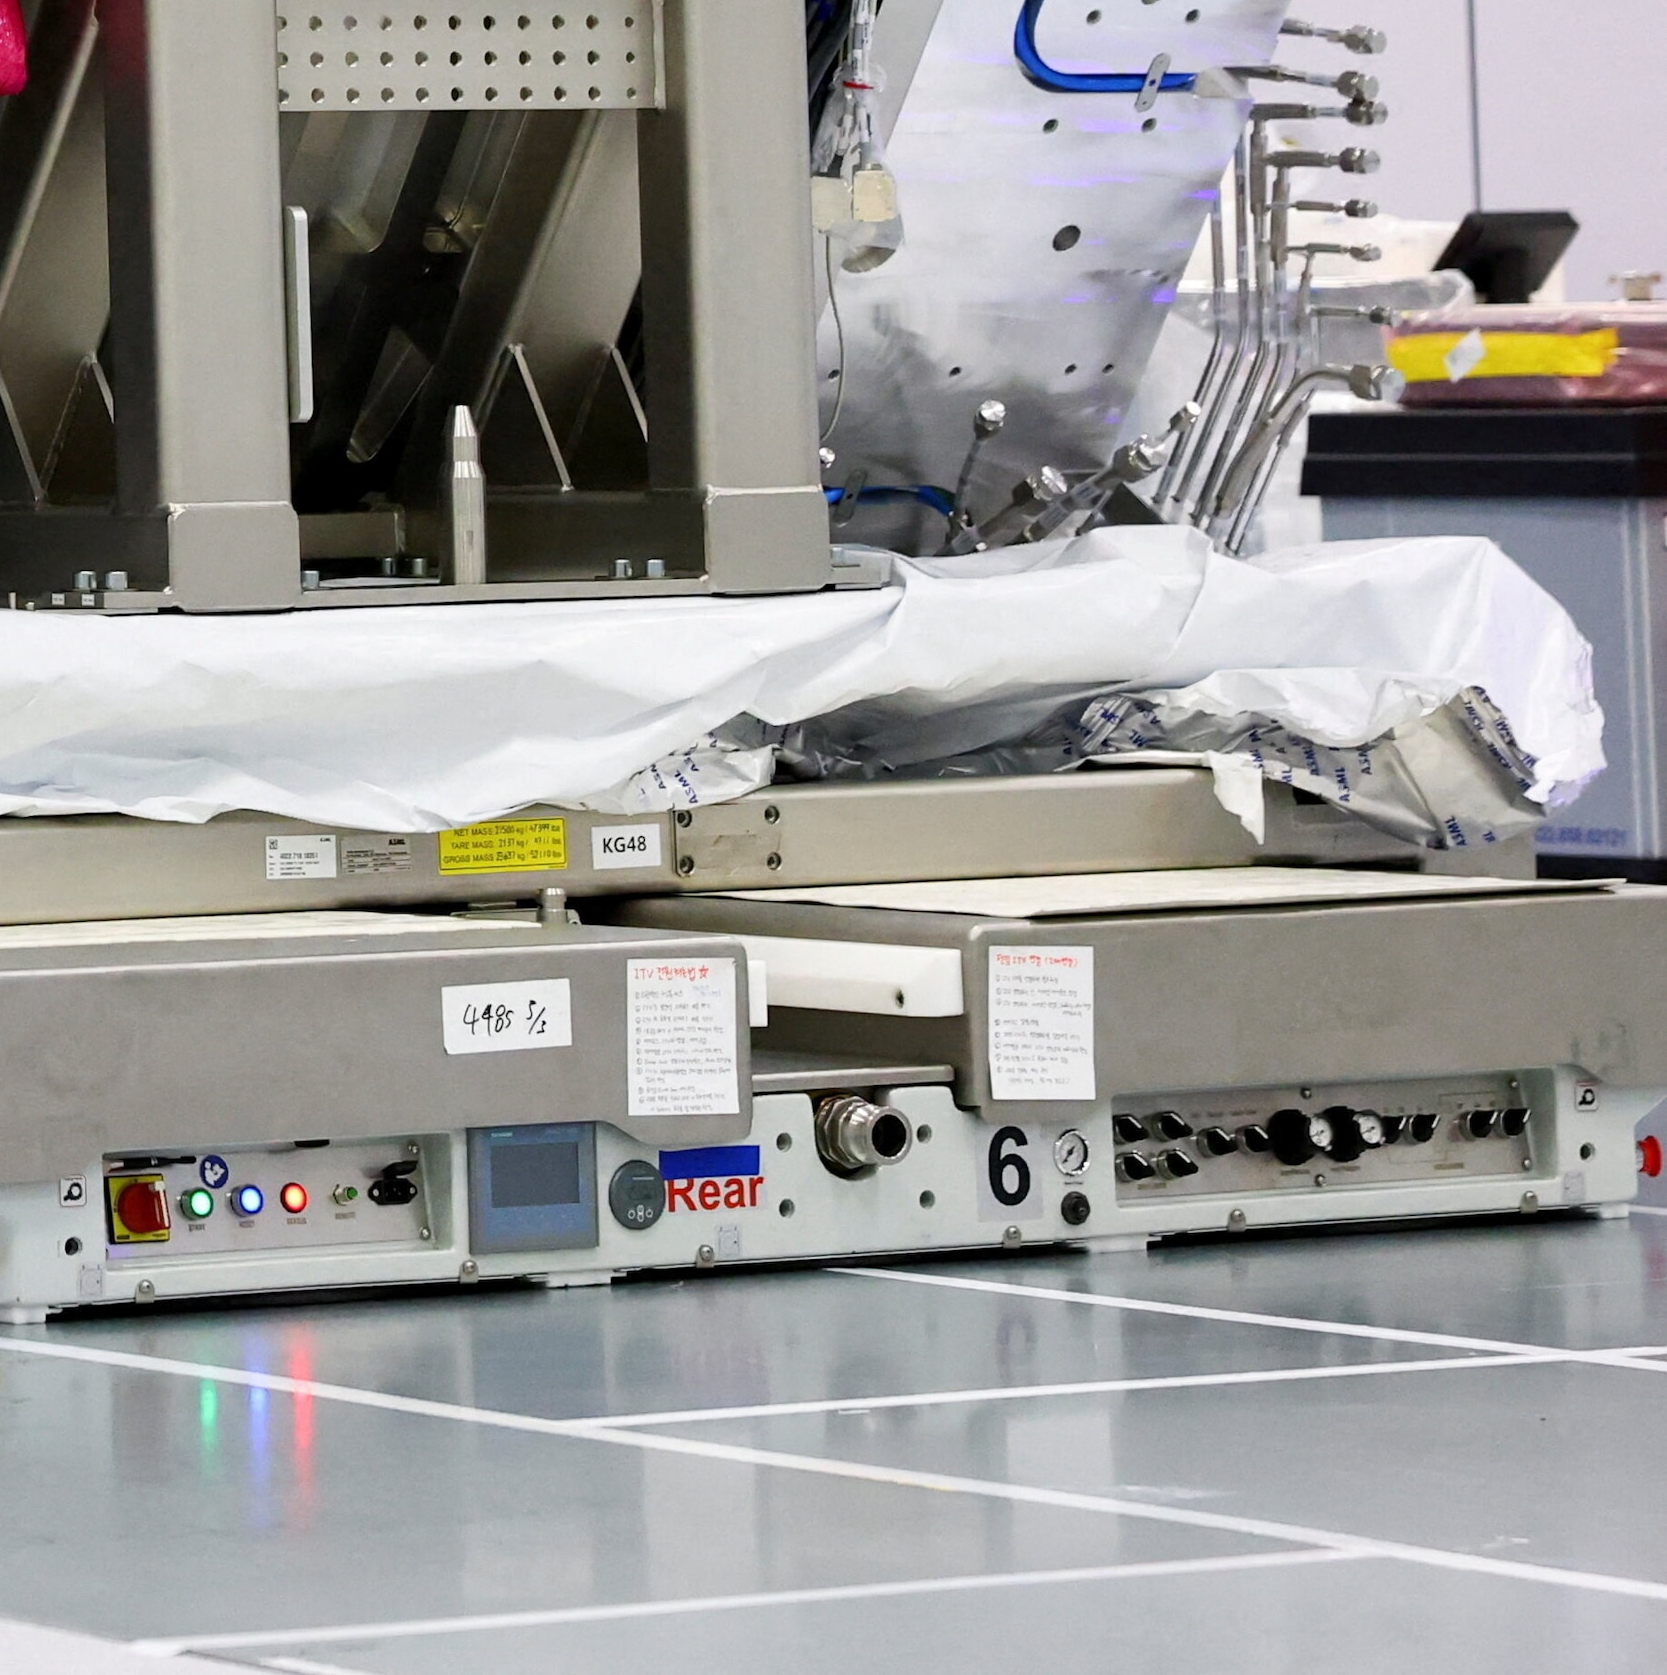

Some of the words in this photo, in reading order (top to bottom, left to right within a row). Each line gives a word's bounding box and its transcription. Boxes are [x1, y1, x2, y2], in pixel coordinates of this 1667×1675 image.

[674, 769, 699, 804] ASML
[1335, 765, 1351, 803] ASML
[602, 835, 647, 854] KG48
[1443, 815, 1468, 847] ASML
[988, 1125, 1031, 1206] 6
[667, 1176, 764, 1213] Rear
